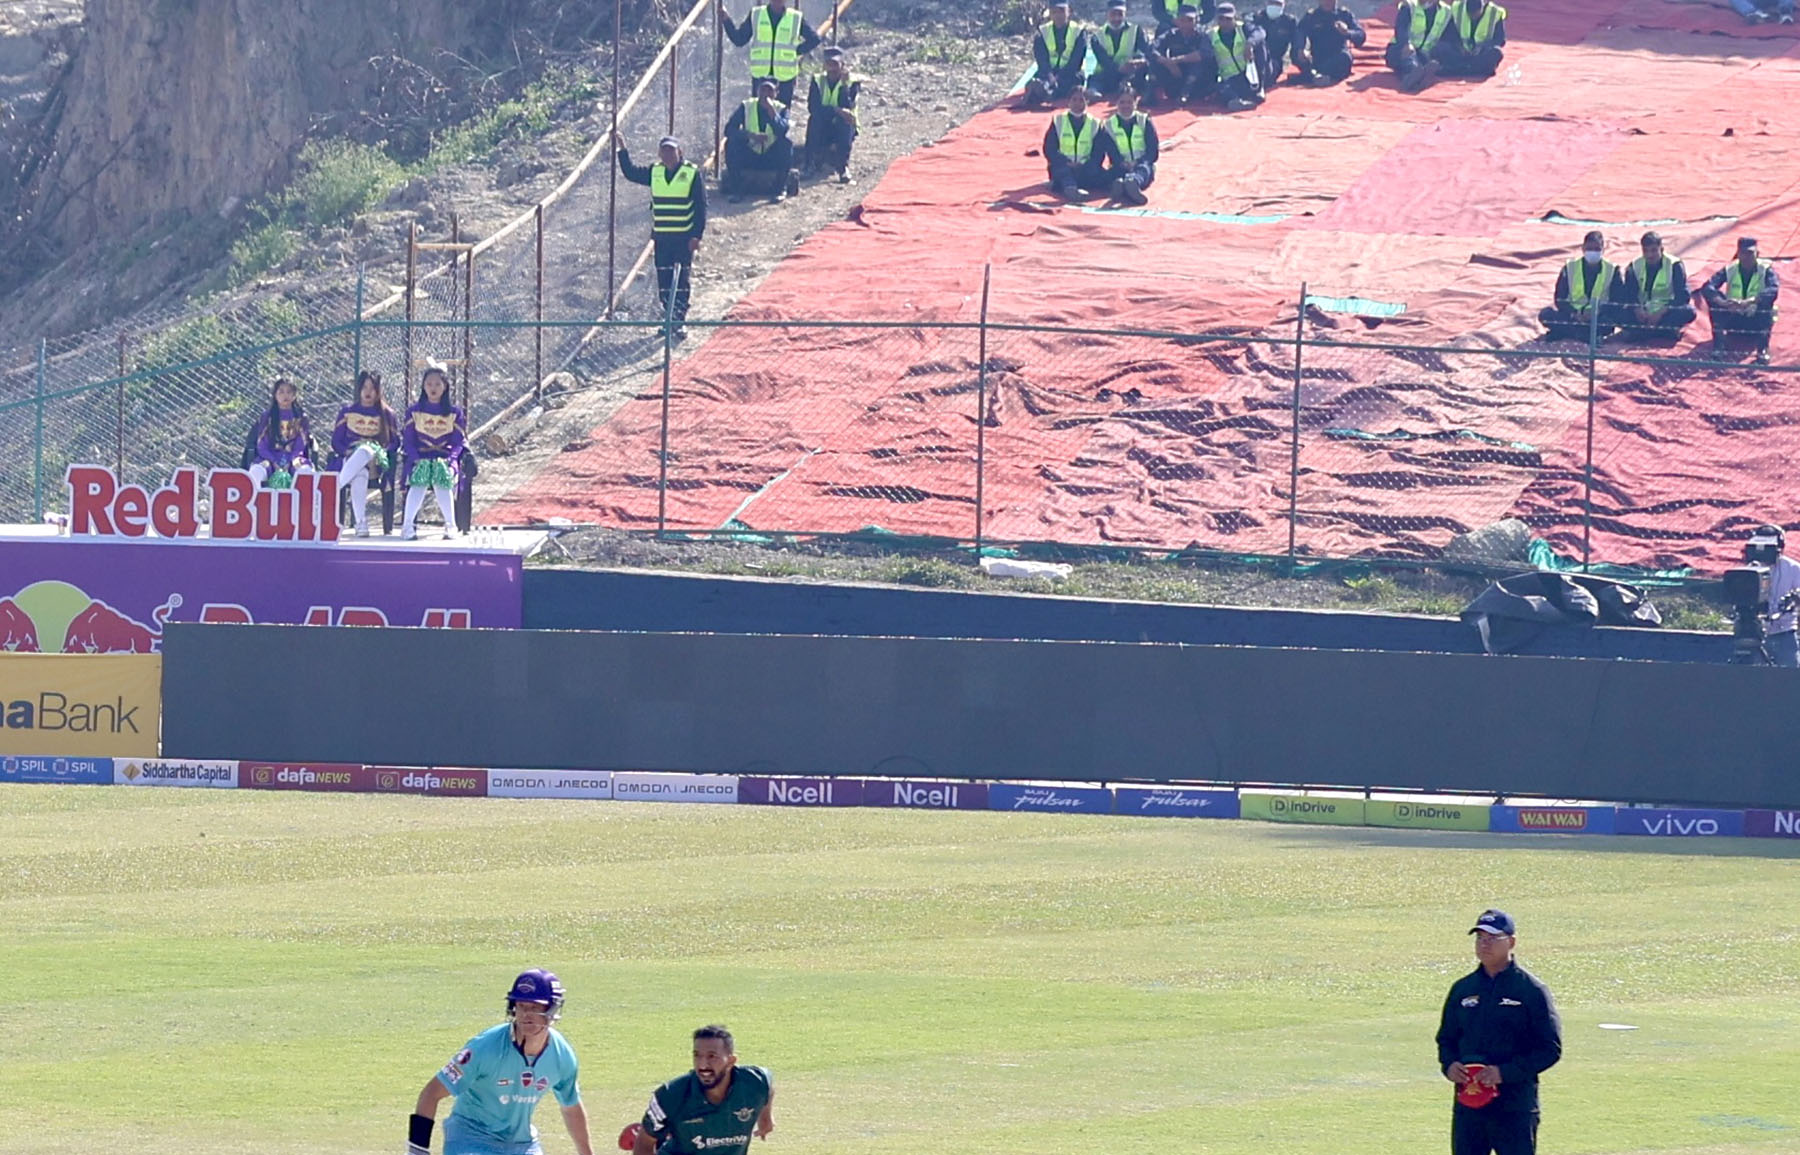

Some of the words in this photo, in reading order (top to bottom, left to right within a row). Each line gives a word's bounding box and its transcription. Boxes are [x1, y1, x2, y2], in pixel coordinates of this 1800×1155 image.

[67, 467, 199, 539] Red
[208, 471, 342, 543] Bull
[21, 759, 48, 772] SPIL
[71, 763, 98, 774] SPIL
[767, 780, 833, 804] Ncell
[892, 783, 958, 807] Ncell
[1290, 801, 1336, 814] inDrive
[1414, 806, 1462, 820] inDrive
[1521, 812, 1551, 826] WAI
[1552, 812, 1584, 826] WAI
[1642, 814, 1719, 835] vivo
